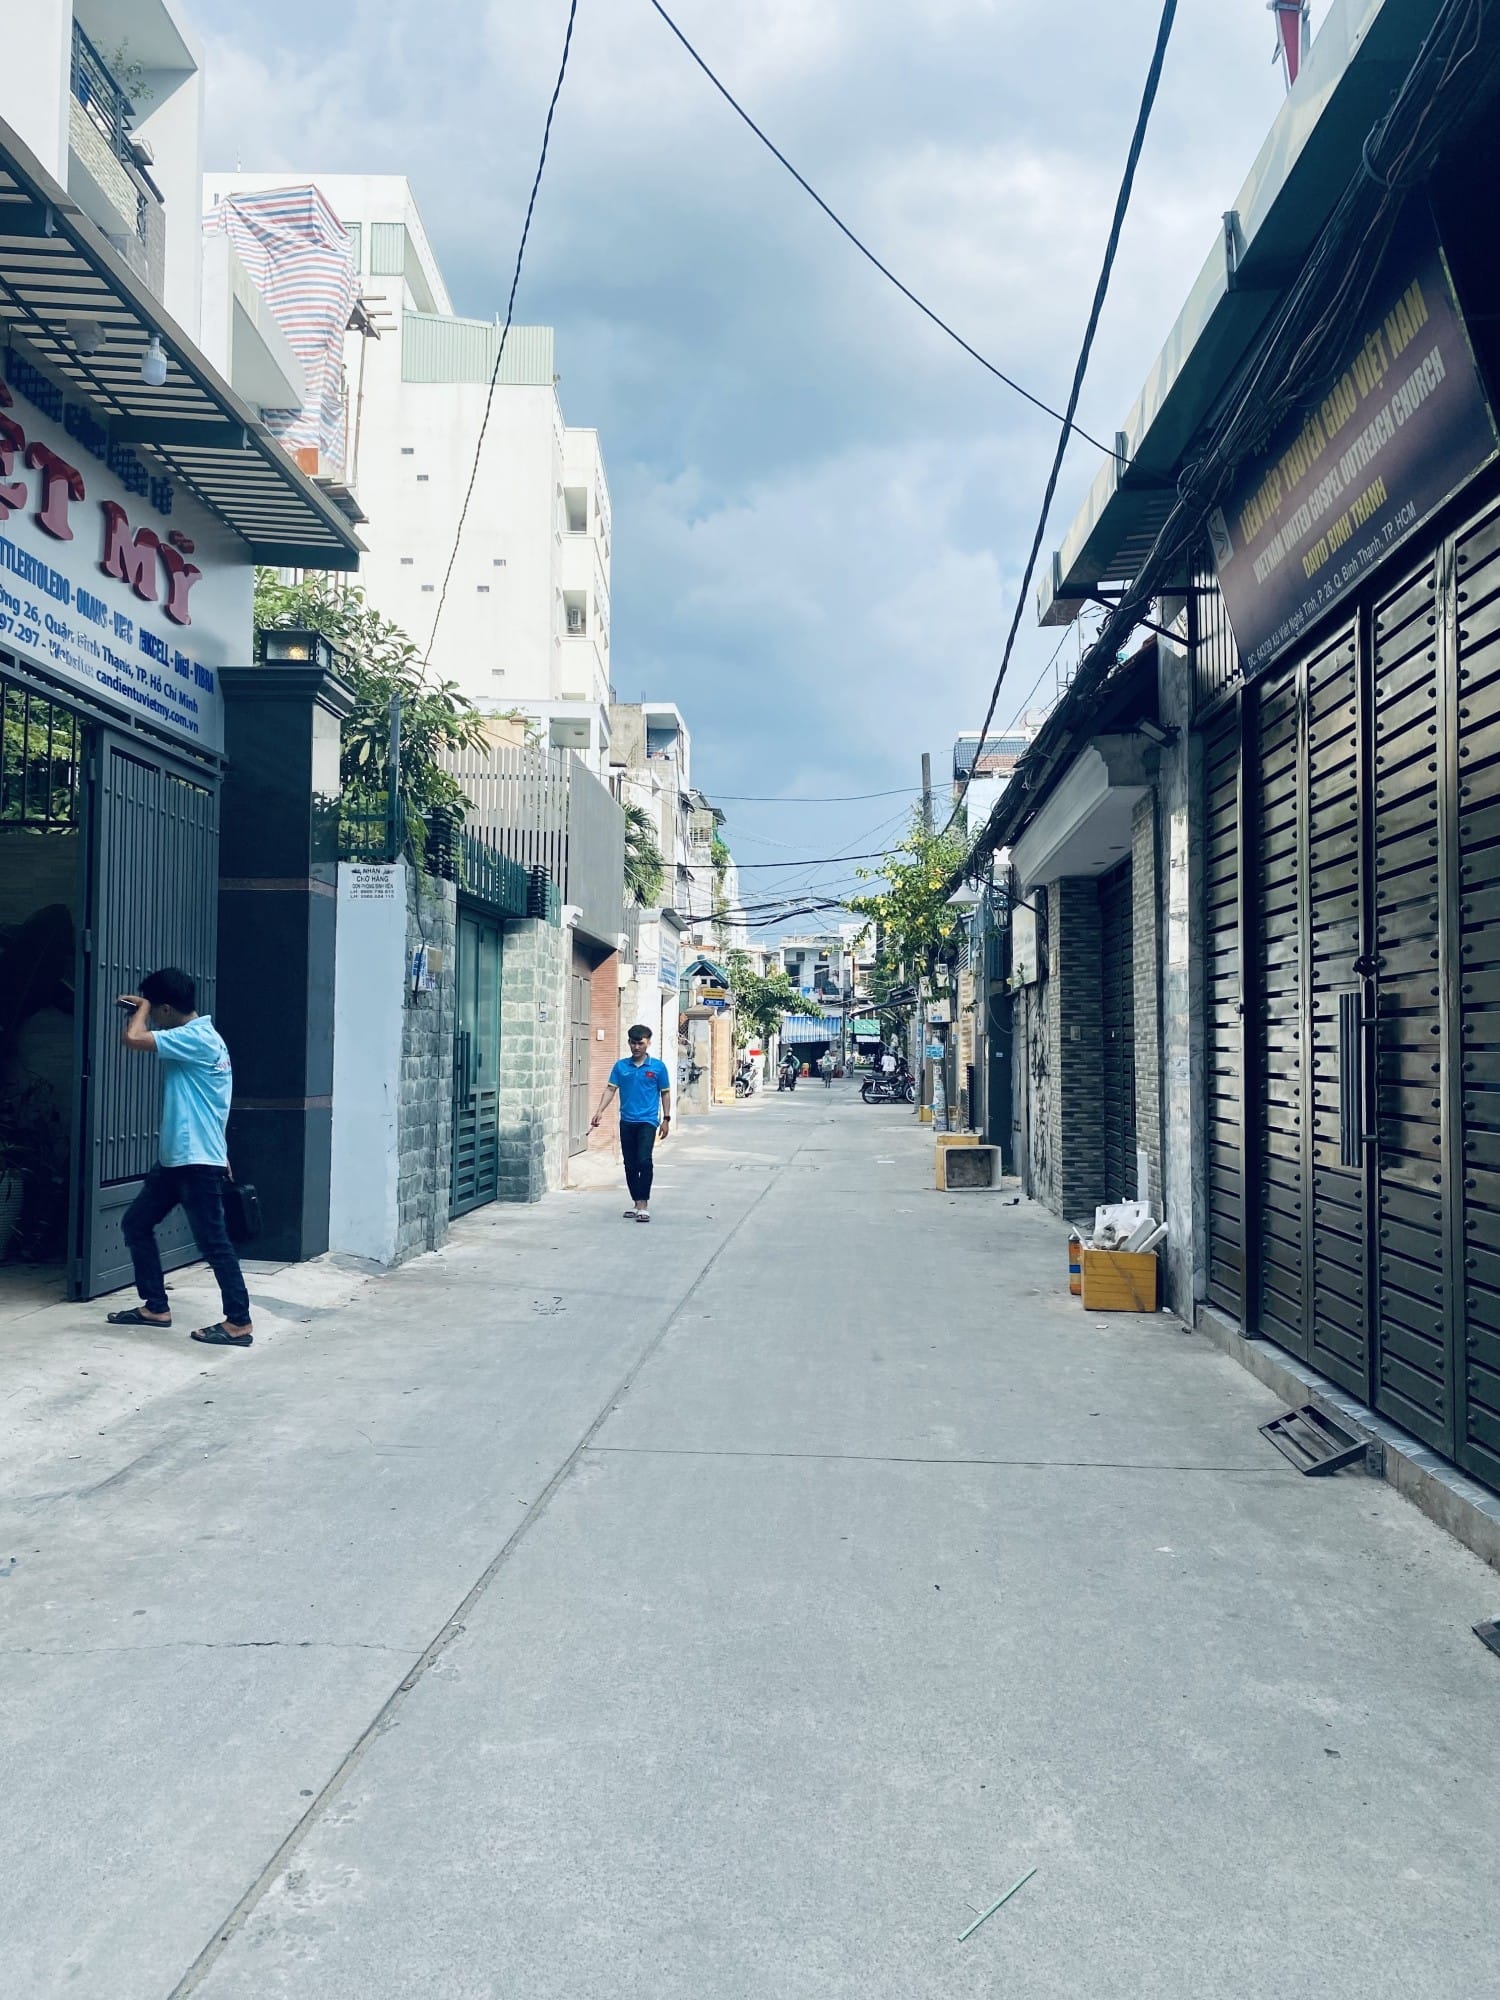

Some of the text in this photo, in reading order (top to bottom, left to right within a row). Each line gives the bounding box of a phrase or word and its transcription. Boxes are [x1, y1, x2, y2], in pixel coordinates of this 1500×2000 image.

[1351, 328, 1389, 399] VIỆT
[1384, 278, 1429, 360] NAM
[1281, 502, 1312, 551] UNITED
[1308, 467, 1344, 521] GOSPEL
[1339, 404, 1396, 486] OUTREACH
[1392, 345, 1446, 426] CHURCH
[1302, 538, 1329, 579] DAVID
[1382, 522, 1397, 542] TP.
[1394, 500, 1417, 531] HCM
[23, 601, 41, 626] 26,
[135, 665, 148, 685] TP.
[179, 691, 199, 714] Minh
[96, 669, 199, 734] candientuvietmy.com.vn
